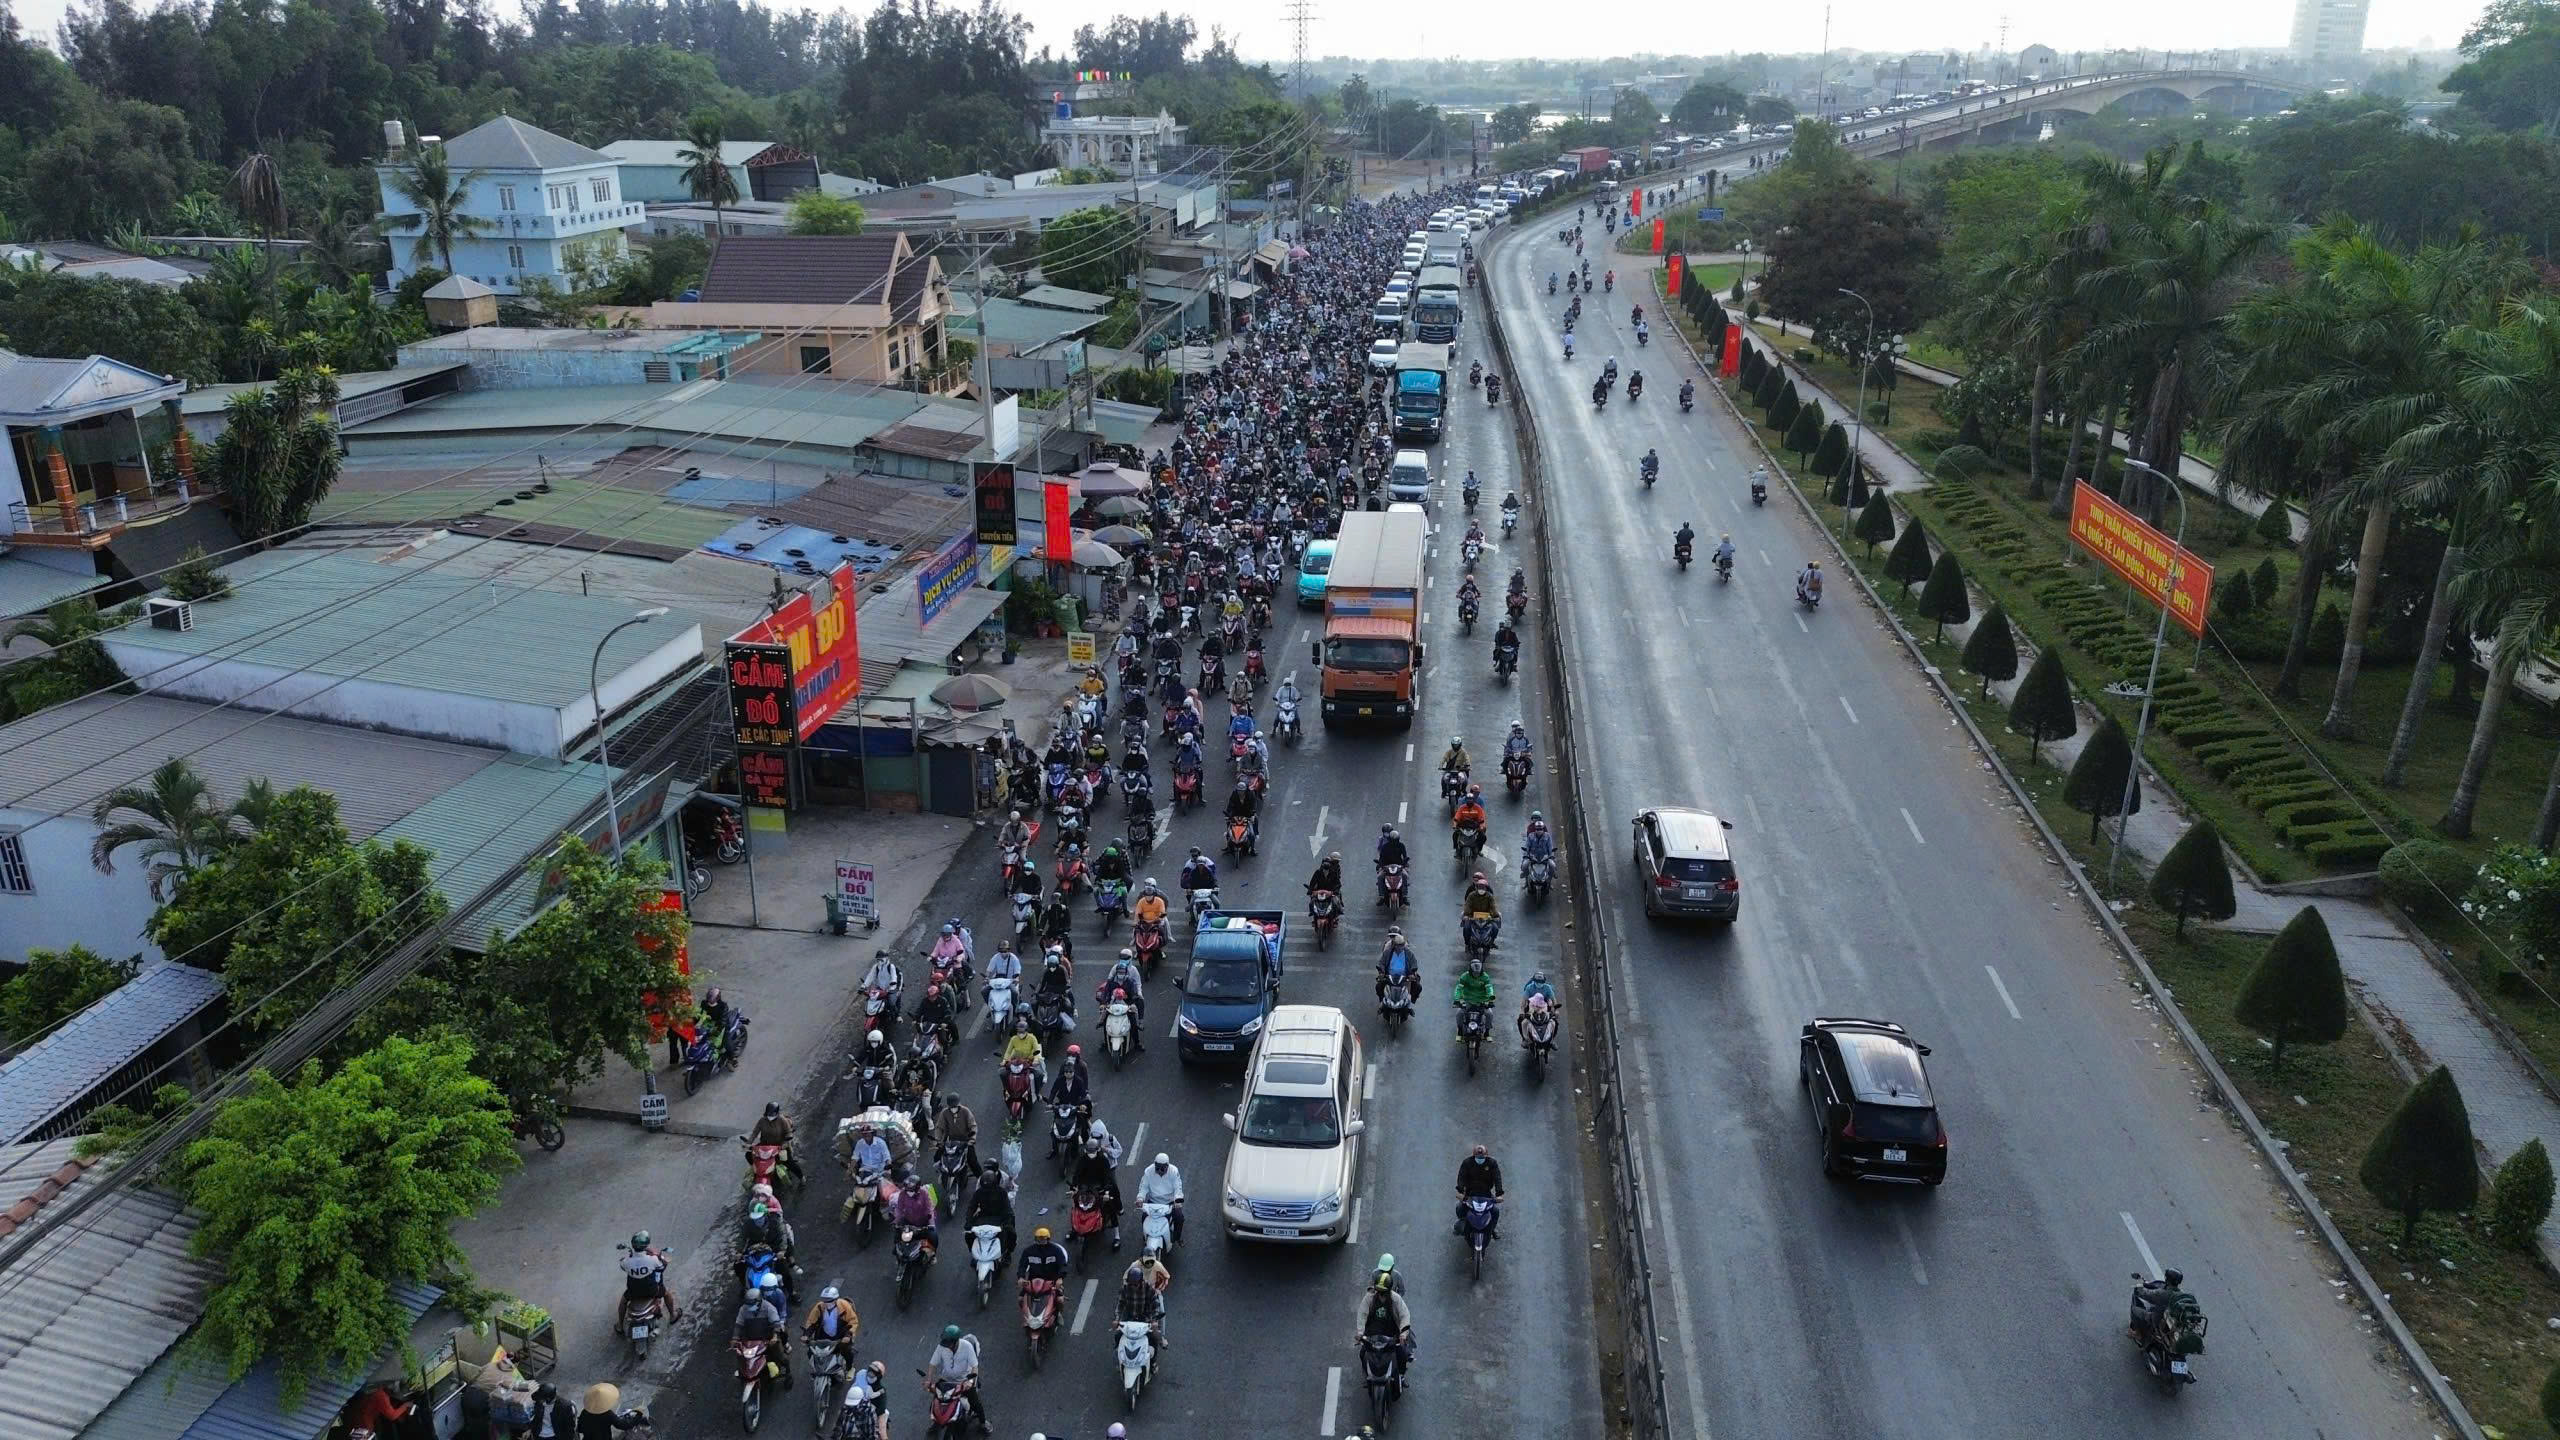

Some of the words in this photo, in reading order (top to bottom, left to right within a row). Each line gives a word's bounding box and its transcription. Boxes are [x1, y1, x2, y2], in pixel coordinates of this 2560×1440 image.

[2090, 504, 2105, 524] TINH
[2121, 526, 2142, 552] CHIẾN
[2143, 541, 2168, 570] THẮNG
[2087, 525, 2104, 548] QUỐC
[2104, 537, 2113, 553] TẾ
[2112, 544, 2125, 564] LAO
[2125, 554, 2145, 578] ĐỘNG
[2146, 569, 2158, 588] 1/5
[924, 581, 941, 606] DỊCH
[941, 571, 952, 591] VỤ
[733, 654, 785, 688] CẦM
[746, 693, 779, 725] ĐỒ
[741, 728, 752, 742] XE
[752, 727, 770, 743] CÁC
[771, 726, 789, 743] TỈNH
[630, 1266, 649, 1276] NO
